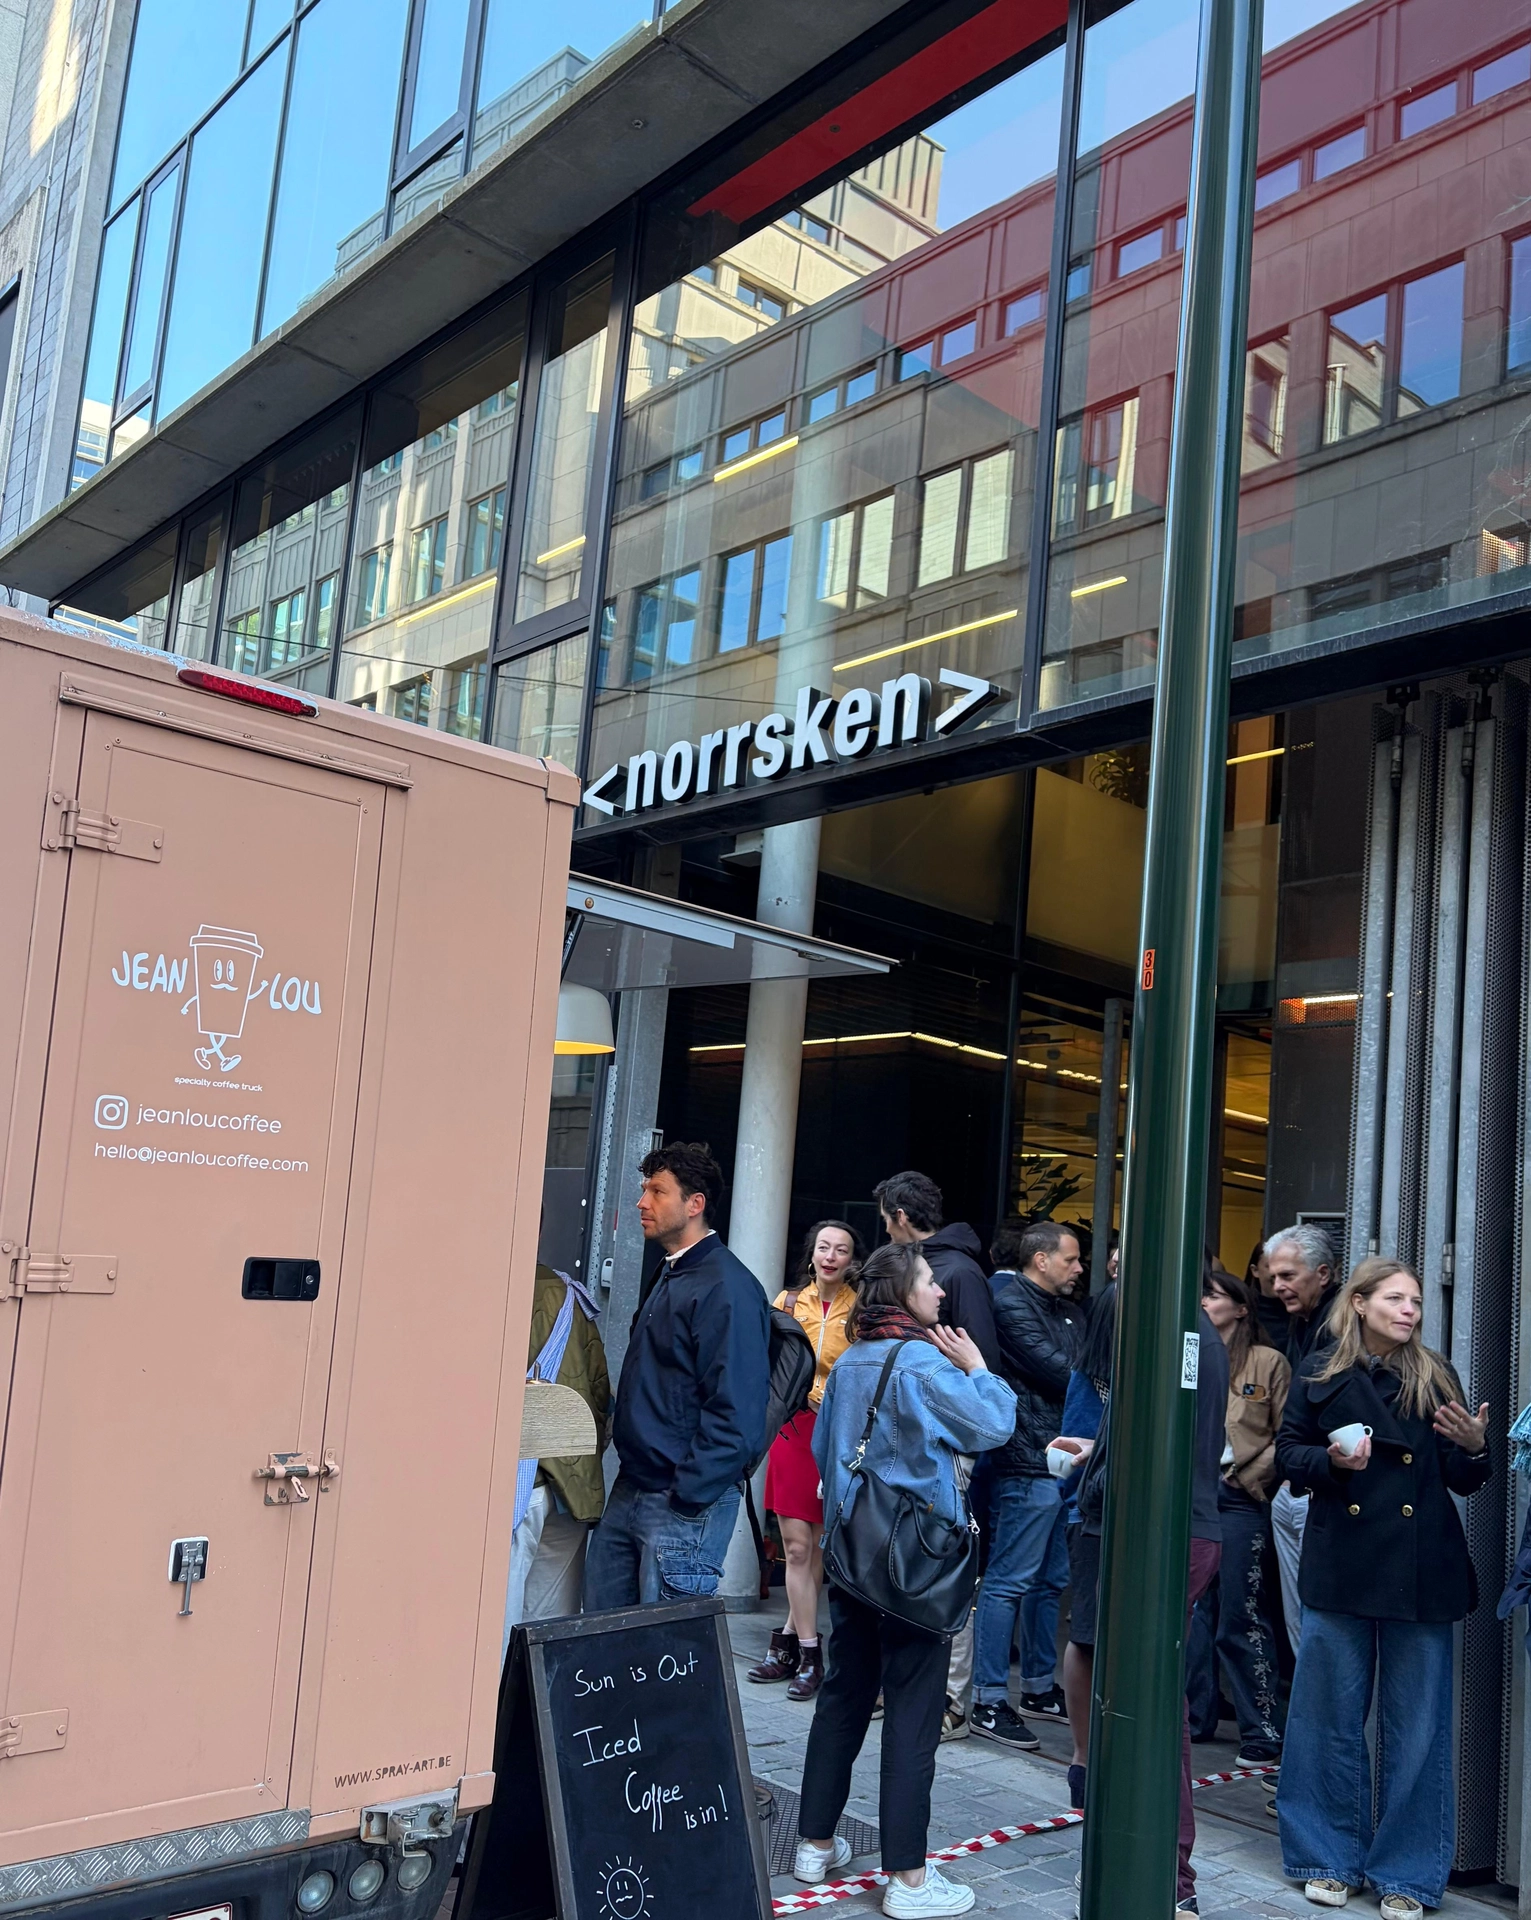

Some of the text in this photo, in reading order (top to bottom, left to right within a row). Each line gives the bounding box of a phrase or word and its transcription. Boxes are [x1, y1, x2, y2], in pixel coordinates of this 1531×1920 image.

[111, 950, 322, 1015] JEAN LOU
[174, 1076, 263, 1092] specialty coffee truck
[136, 1103, 282, 1134] jeanloucoffee
[94, 1142, 309, 1172] hello@jeanloucoffee.com
[574, 1651, 699, 1697] Sun is Out
[573, 1718, 642, 1767] Iced
[334, 1755, 452, 1789] WWW.SPRAY-ART.BE
[625, 1771, 684, 1832] Coffee
[684, 1810, 698, 1830] is
